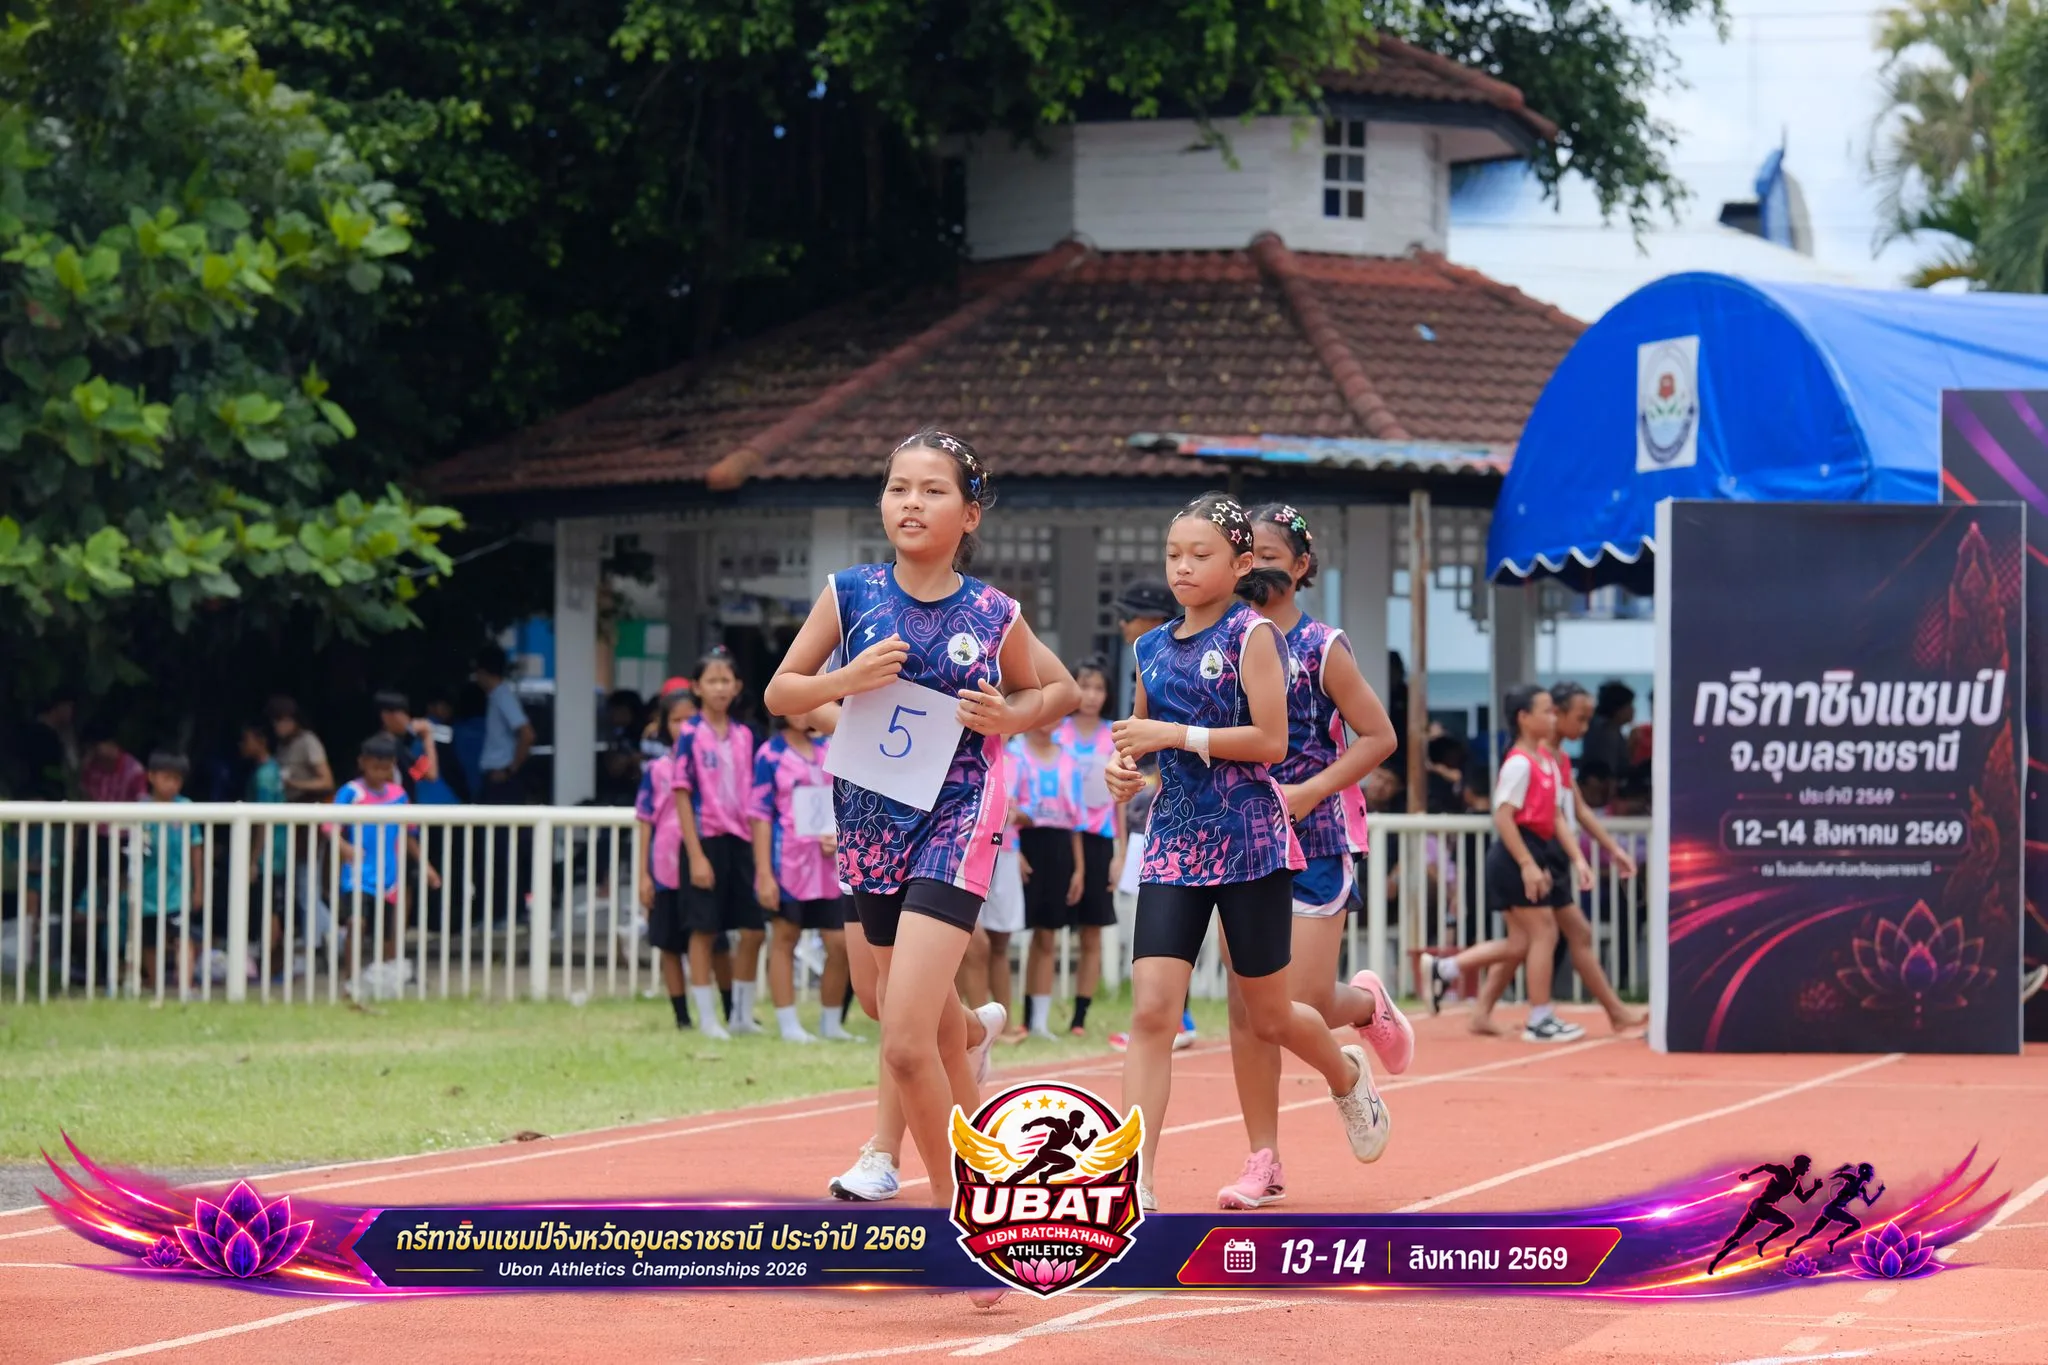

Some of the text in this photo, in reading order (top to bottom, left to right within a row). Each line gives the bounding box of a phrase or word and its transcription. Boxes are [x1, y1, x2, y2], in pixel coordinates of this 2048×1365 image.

[1693, 667, 2007, 727] กรีฑาชิงแชมป์
[879, 704, 927, 758] 5
[1730, 730, 1961, 783] จ.อุบลราชธานี
[1855, 787, 1895, 805] 2569
[1813, 818, 1899, 846] สิงหาคม
[1904, 820, 1964, 846] 2569
